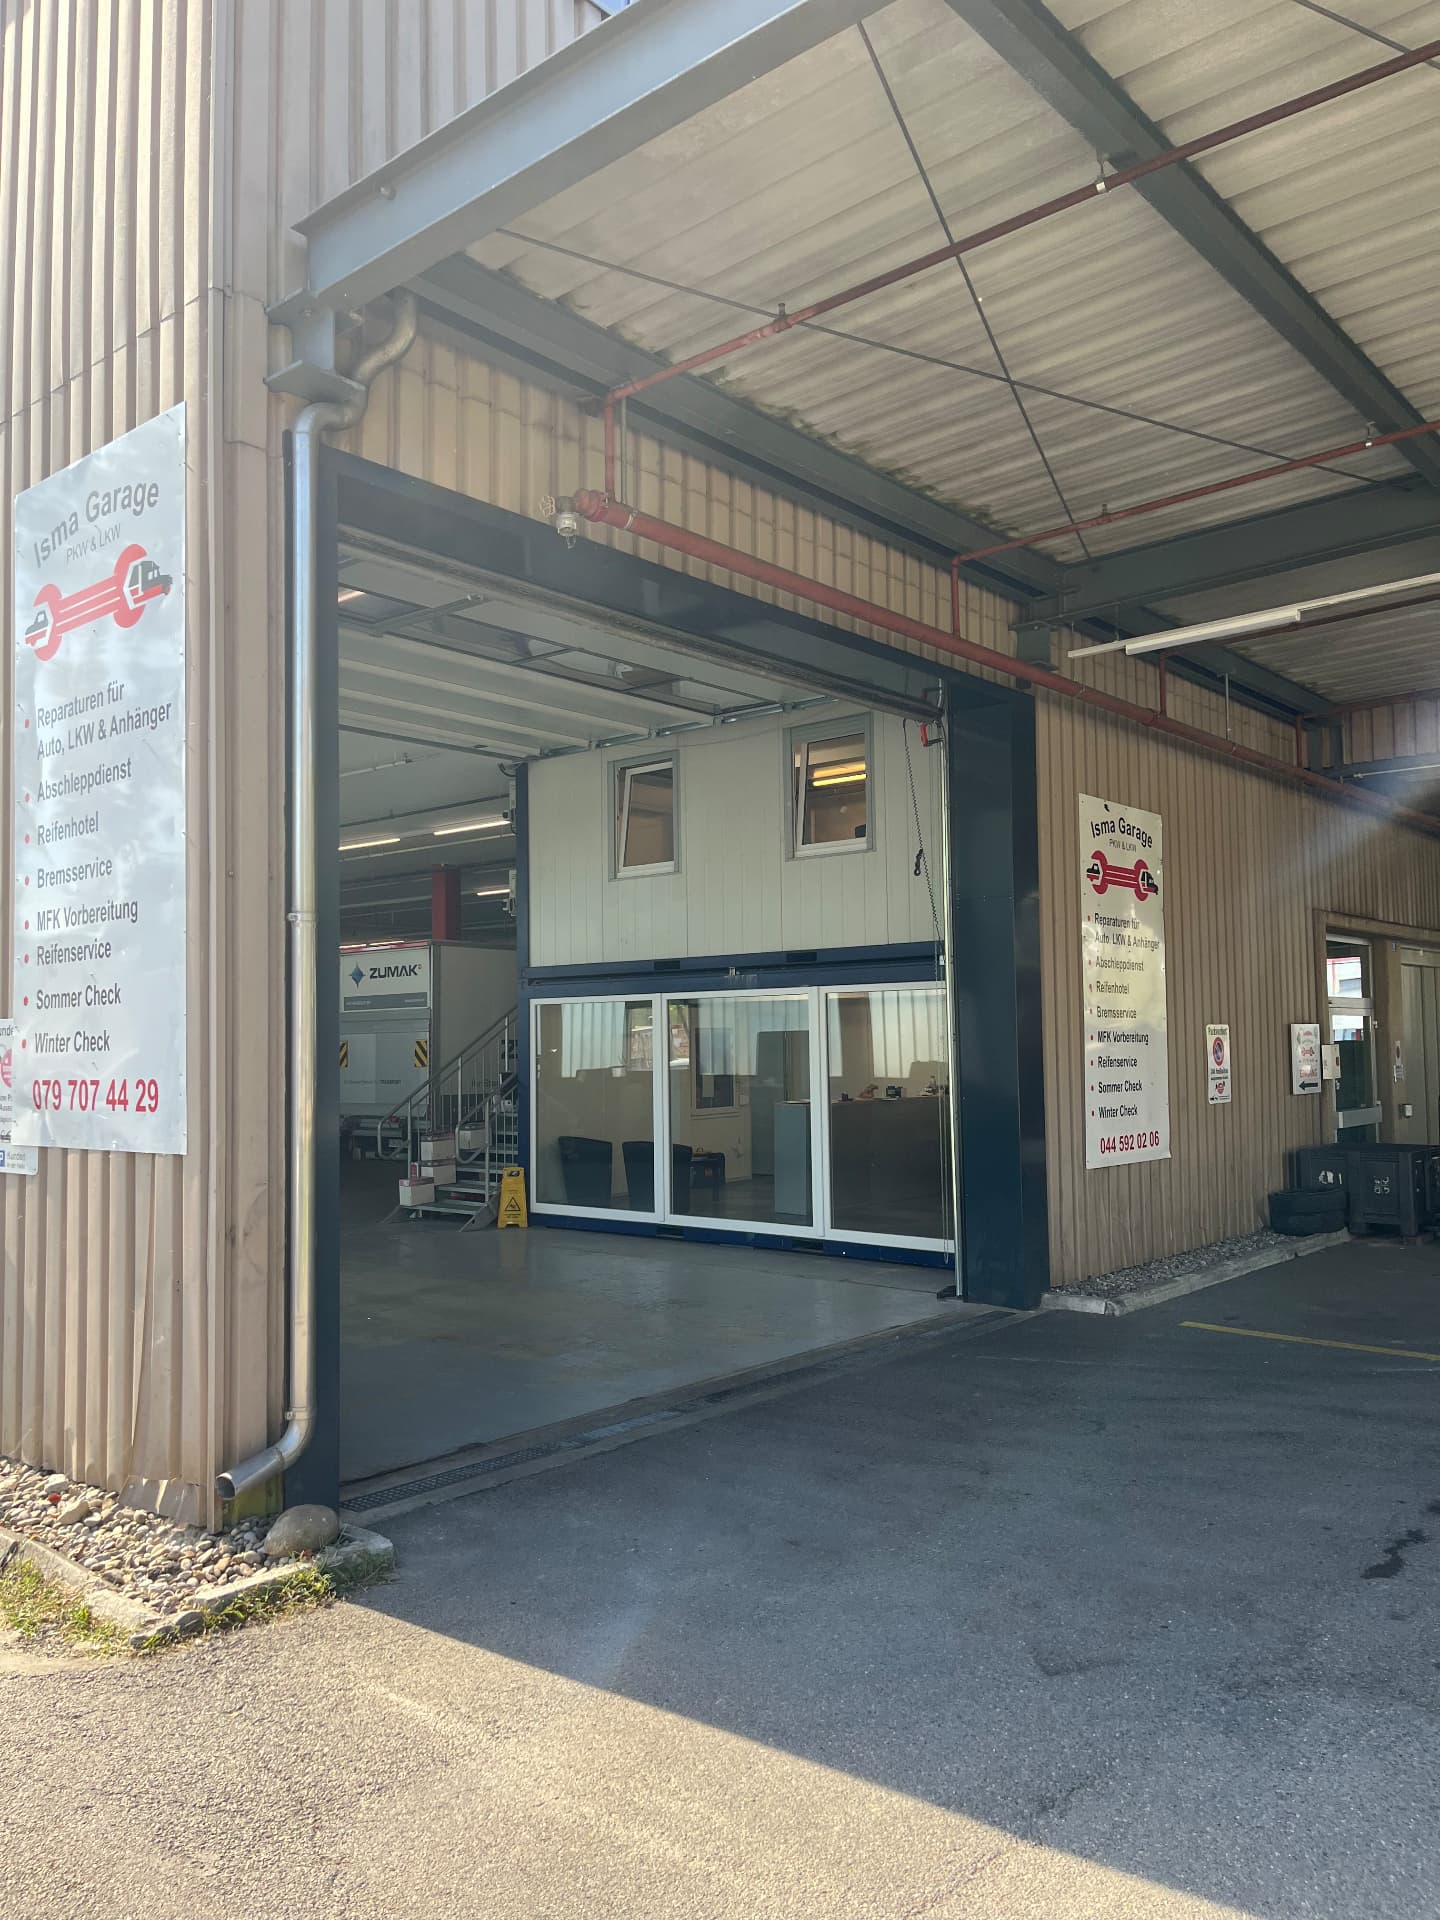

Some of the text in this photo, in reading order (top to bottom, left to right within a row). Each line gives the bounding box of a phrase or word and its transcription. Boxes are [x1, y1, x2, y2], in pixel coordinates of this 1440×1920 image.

[34, 482, 160, 568] Isma Garage
[66, 523, 121, 566] PKW & LKW
[37, 680, 125, 728] Reparaturen für
[37, 702, 172, 761] Auto, LKW & Anhänger
[37, 758, 132, 803] Abschleppdienst
[37, 810, 99, 846] Reifenhotel
[1090, 817, 1153, 848] Isma Garage
[37, 857, 113, 888] Bremsservice
[37, 899, 138, 932] MFK Vorbereitung
[1094, 912, 1140, 930] Reparaturen für
[37, 938, 112, 967] Reifenservice
[1112, 934, 1126, 946] LKW
[1127, 936, 1132, 947] &
[1133, 936, 1160, 952] Anhänger
[1096, 956, 1145, 973] Abschleppdienst
[36, 982, 121, 1010] Sommer Check
[1096, 981, 1129, 995] Reifenhotel
[1096, 1006, 1137, 1019] Bremsservice
[34, 1029, 111, 1054] Winter Check
[1097, 1030, 1149, 1046] MFK Vorbereitung
[1097, 1055, 1138, 1069] Reifenservice
[33, 1078, 159, 1113] 079 707 44 29
[1098, 1079, 1143, 1094] Sommer Check
[1098, 1104, 1138, 1119] Winter Check
[1100, 1130, 1160, 1154] 044 592 02 06
